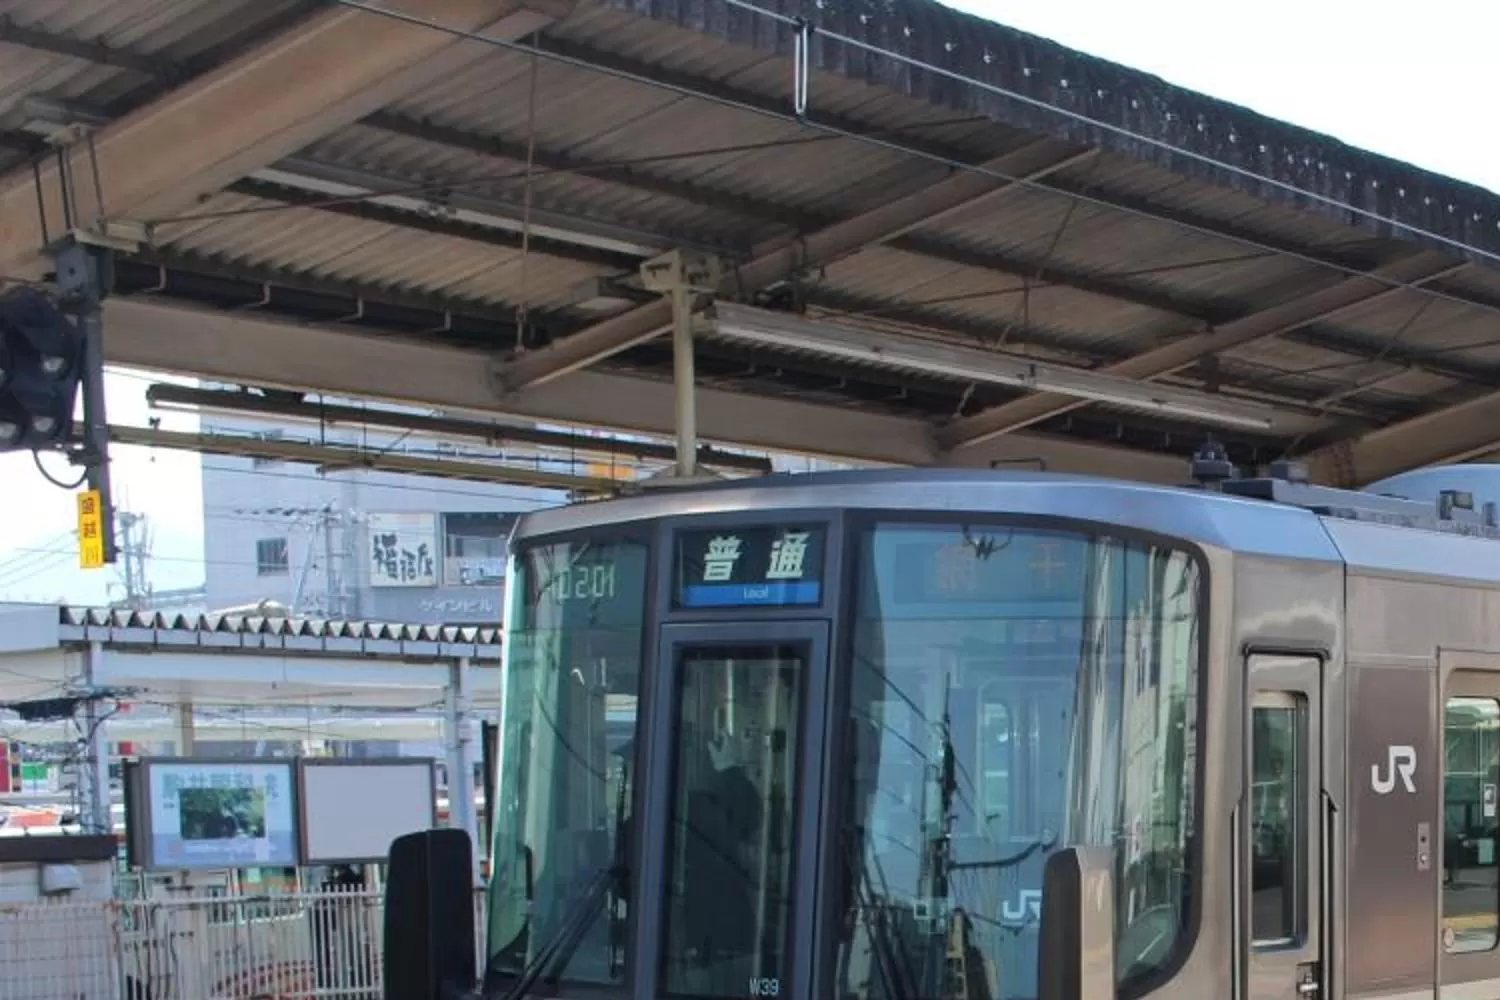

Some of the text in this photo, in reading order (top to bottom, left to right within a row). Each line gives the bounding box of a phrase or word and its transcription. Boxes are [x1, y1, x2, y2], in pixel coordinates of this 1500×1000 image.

[703, 532, 811, 581] 普通
[1371, 745, 1417, 794] JR
[749, 977, 779, 997] W39
